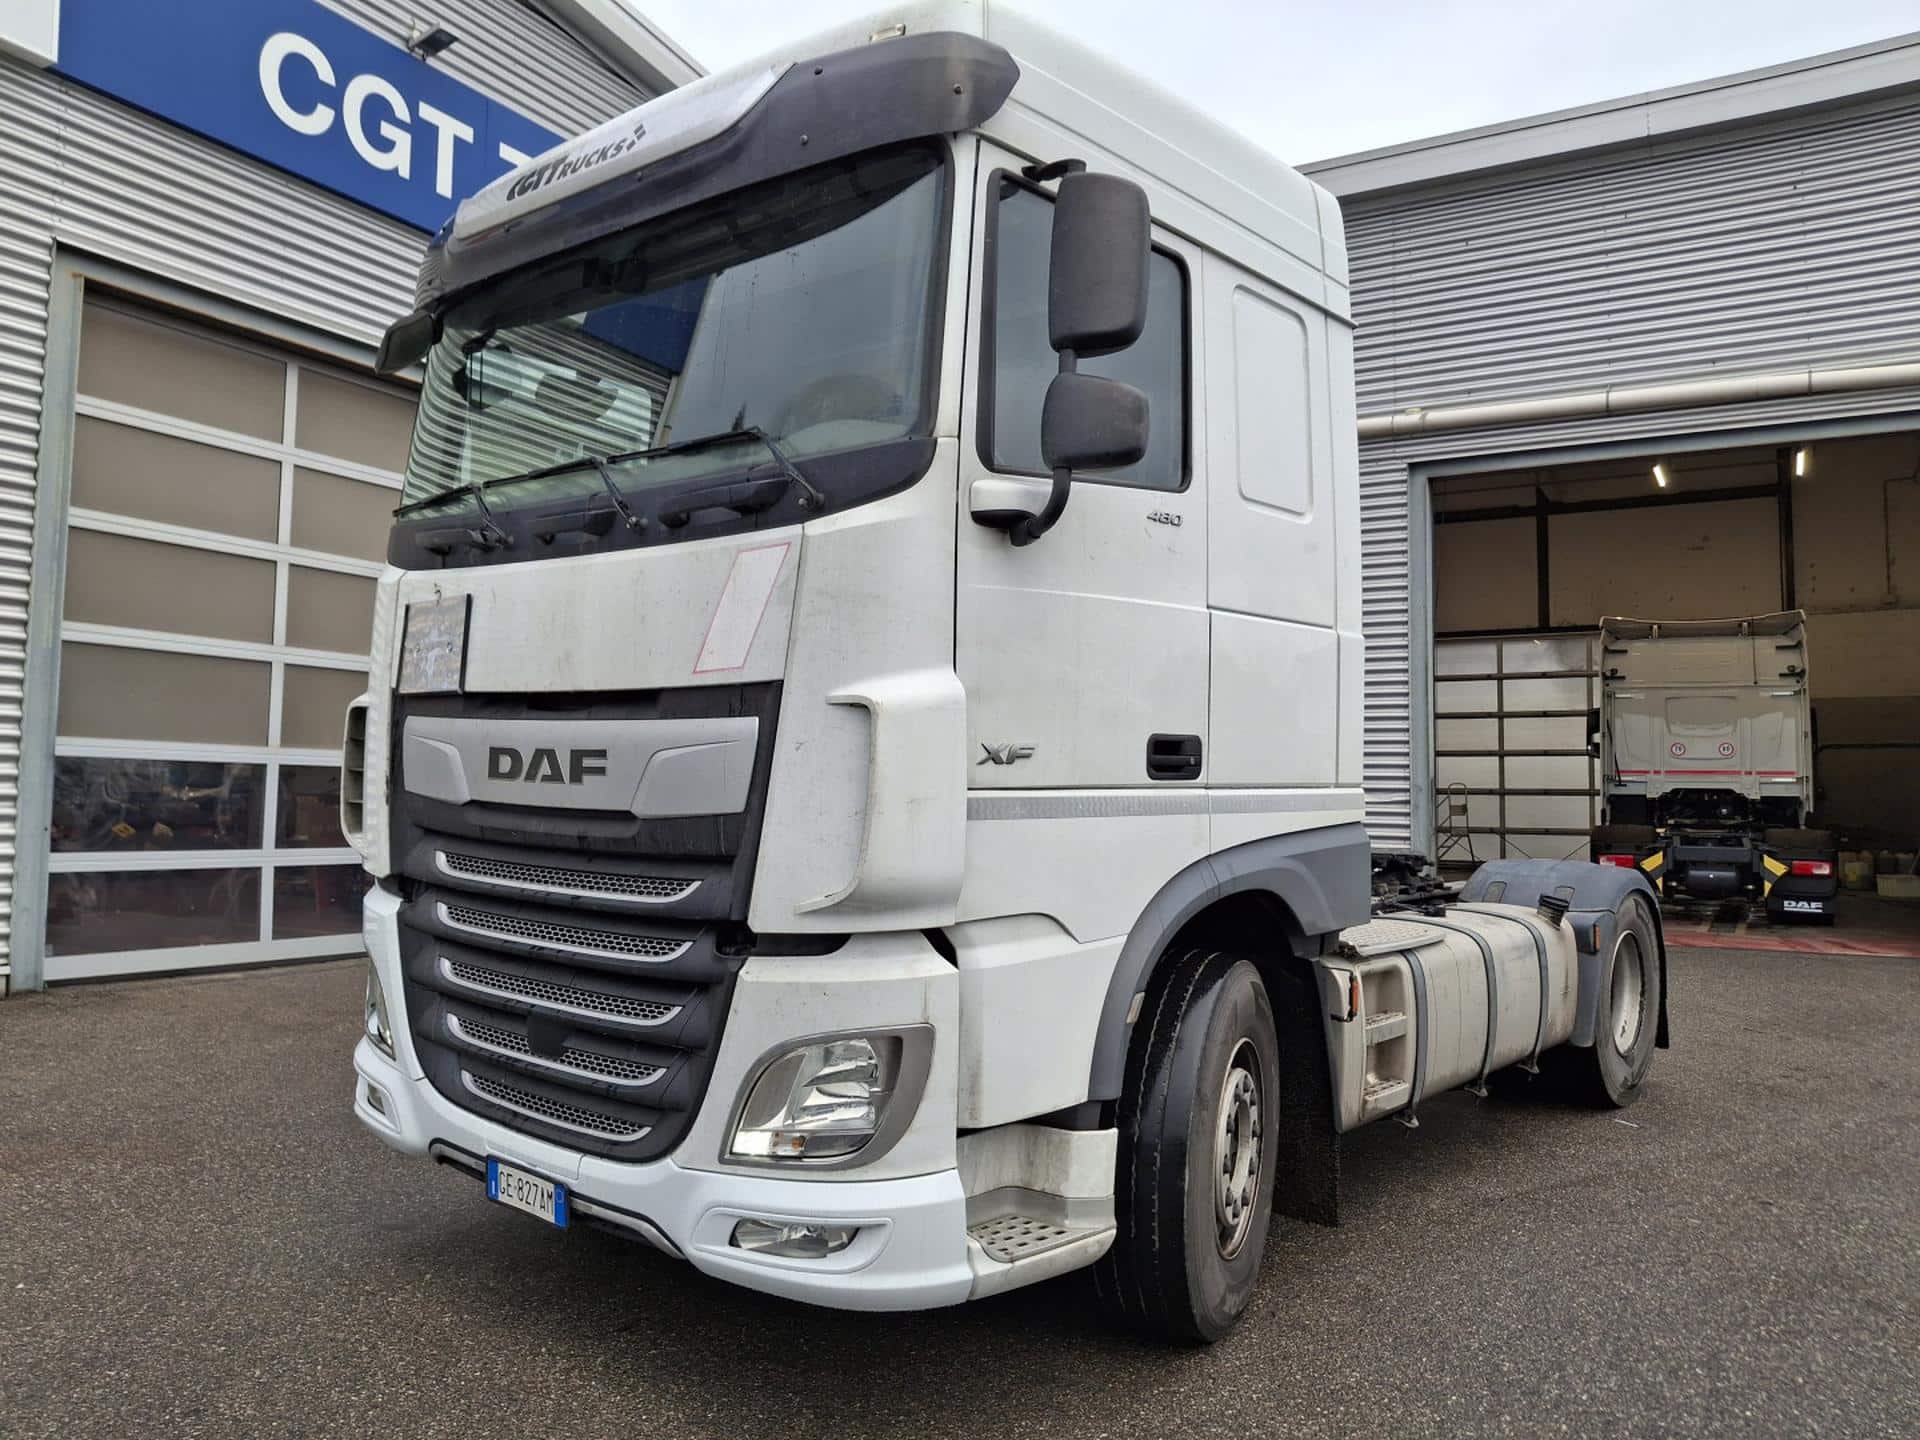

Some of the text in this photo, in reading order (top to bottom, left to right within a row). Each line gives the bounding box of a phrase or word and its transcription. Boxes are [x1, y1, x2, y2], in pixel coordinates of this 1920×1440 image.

[259, 32, 474, 199] CGT
[487, 746, 608, 785] DAF
[976, 743, 1036, 765] XF
[1783, 900, 1823, 909] DAF
